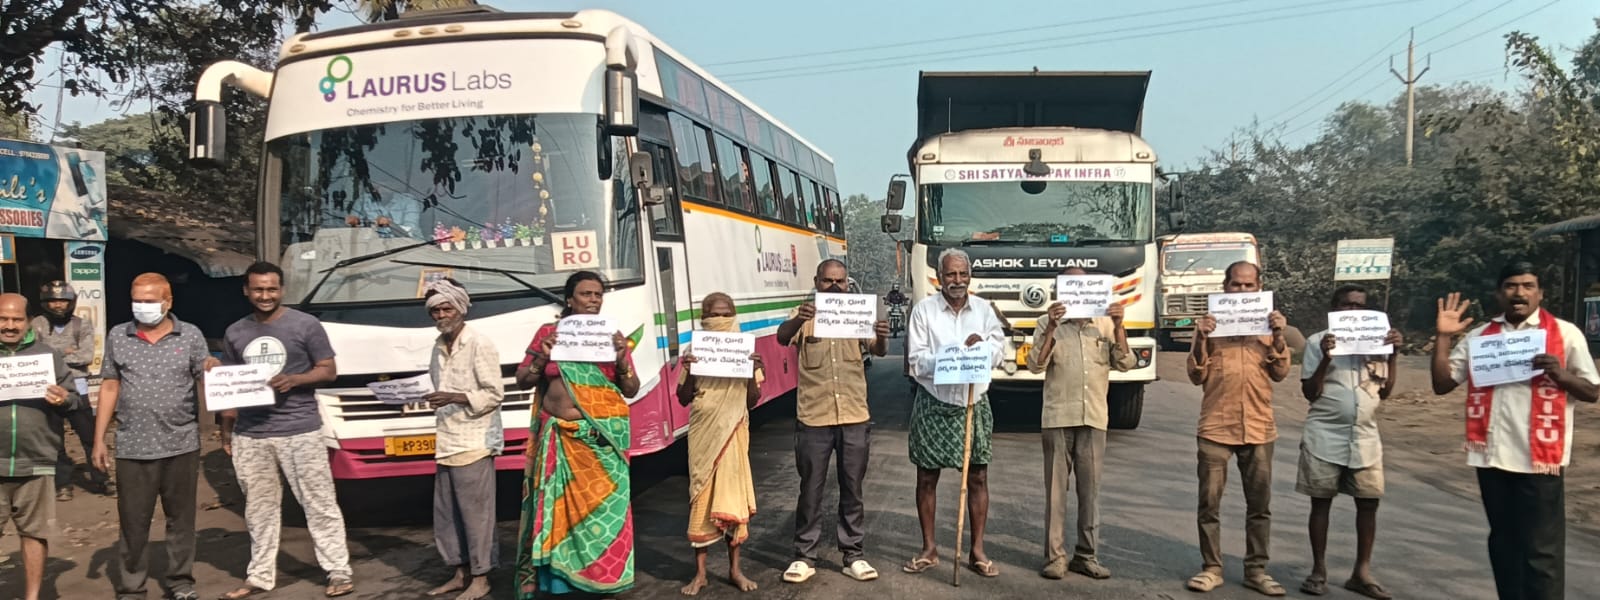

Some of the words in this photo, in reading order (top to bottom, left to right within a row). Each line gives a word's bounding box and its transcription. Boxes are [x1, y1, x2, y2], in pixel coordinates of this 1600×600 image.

[347, 72, 447, 99] LAURUS
[452, 70, 512, 91] Labs
[346, 105, 398, 117] Chemistry
[401, 104, 416, 113] for
[417, 102, 449, 112] Better
[451, 99, 484, 110] Living
[959, 170, 979, 180] SRI
[983, 168, 1022, 180] SATYA
[1075, 168, 1111, 179] INFRA
[74, 249, 98, 257] SAMSUNG
[972, 258, 1024, 268] ASHOK
[1030, 258, 1098, 268] LEYLAND
